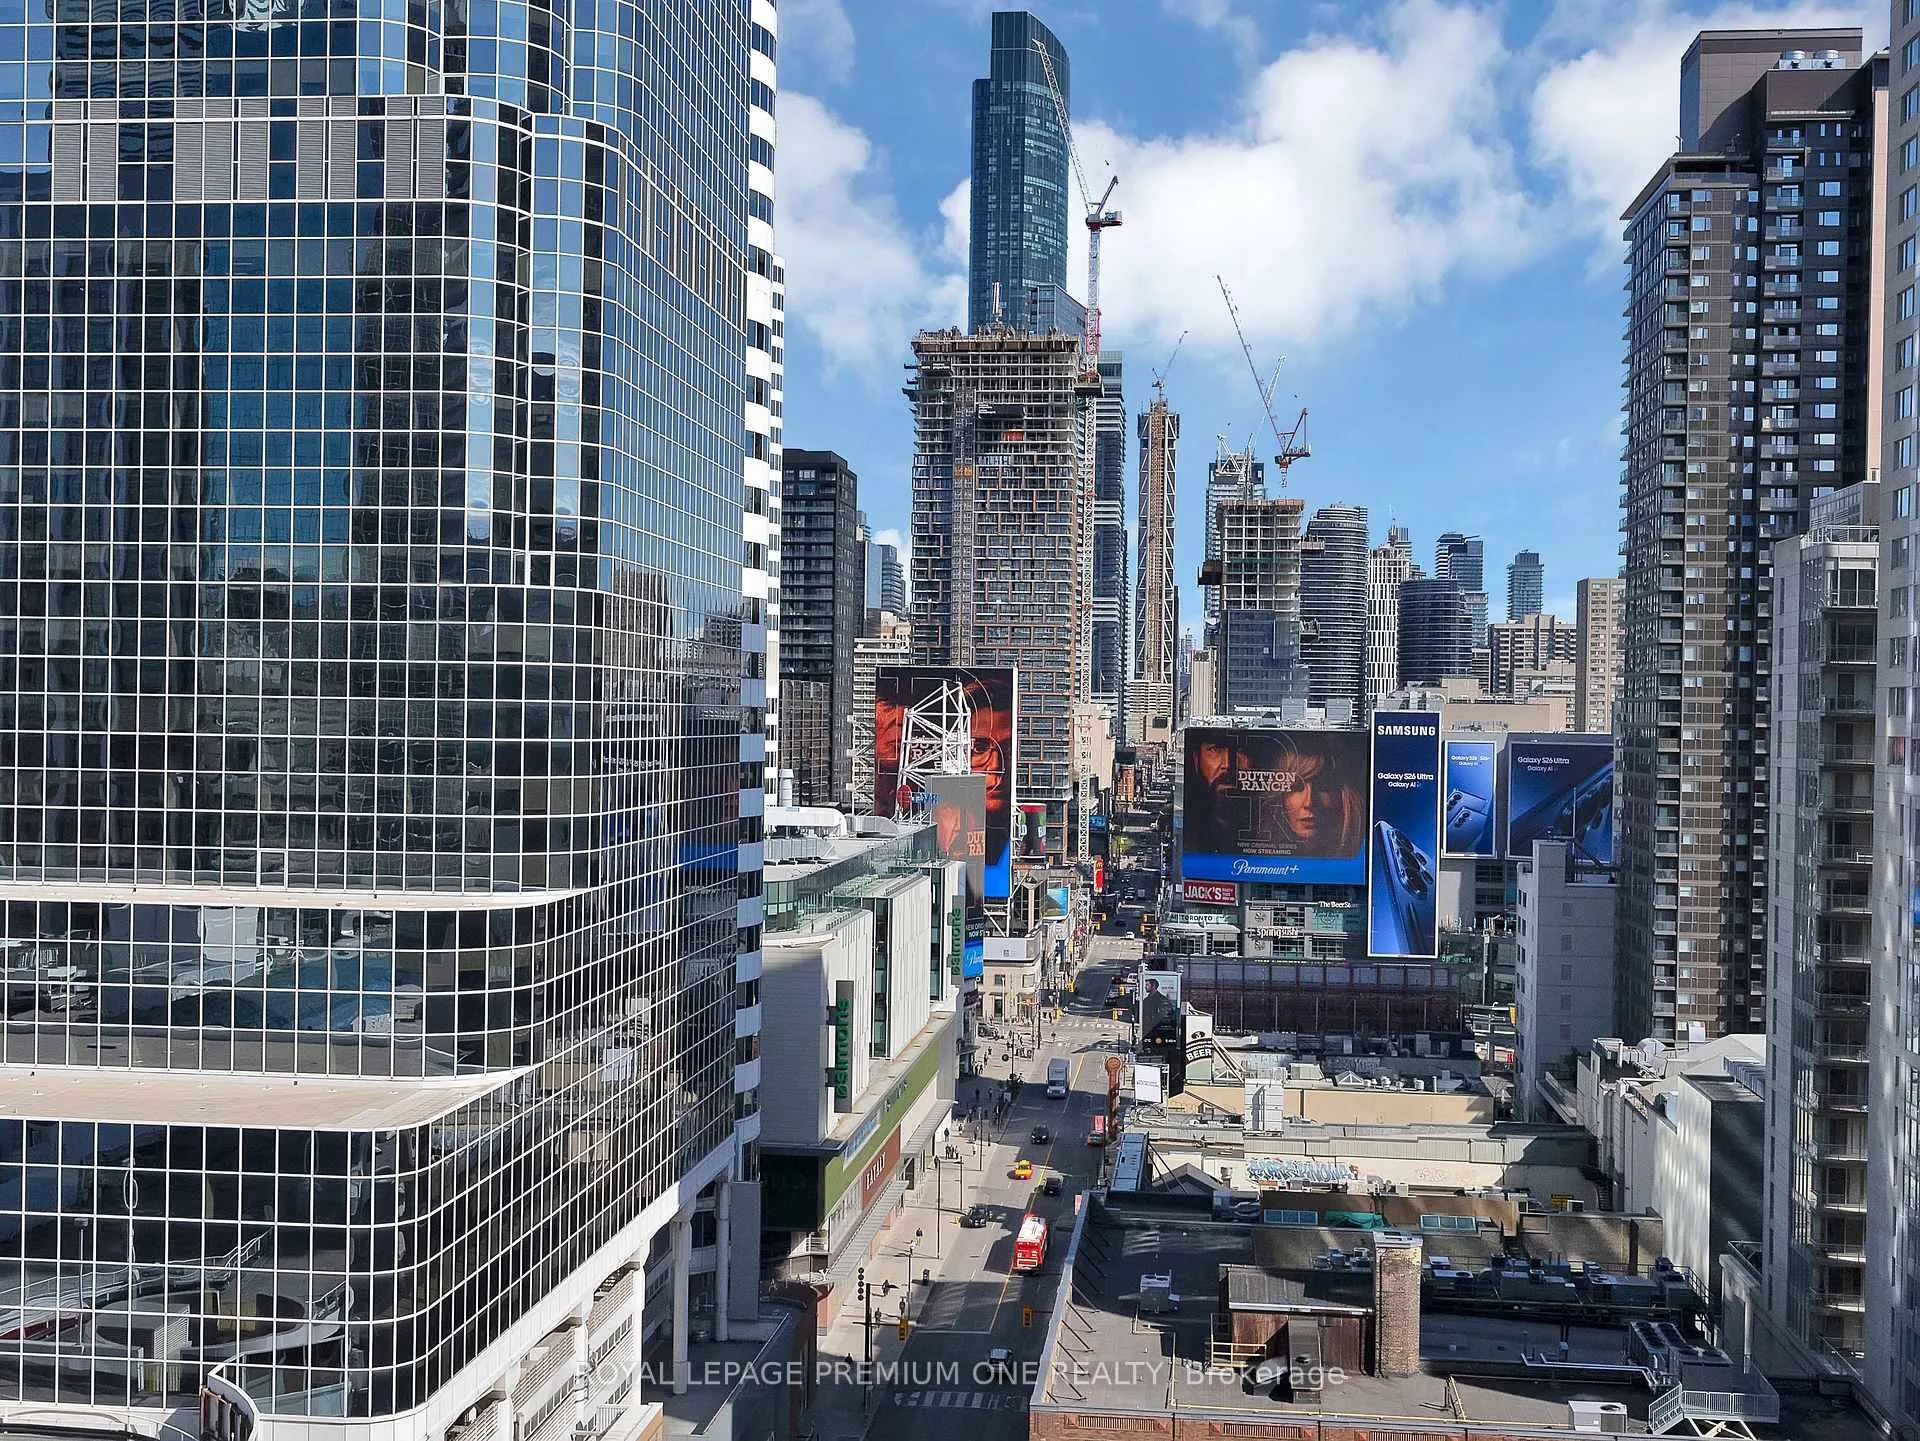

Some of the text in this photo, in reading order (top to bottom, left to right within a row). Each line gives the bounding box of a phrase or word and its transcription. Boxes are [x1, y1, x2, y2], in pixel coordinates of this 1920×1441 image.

[1377, 725, 1436, 736] SAMSUNG
[1518, 756, 1541, 764] Galaxy
[1527, 765, 1547, 773] Galaxy
[1238, 770, 1296, 782] DUTTON
[1377, 772, 1434, 781] Galaxy S26 Ultra
[1241, 781, 1292, 792] RANCH
[1388, 781, 1410, 789] Galaxy
[1231, 859, 1300, 876] Paramount+
[1185, 885, 1222, 900] JACK'S
[1186, 1049, 1211, 1061] BEER
[866, 1151, 886, 1191] EATALY
